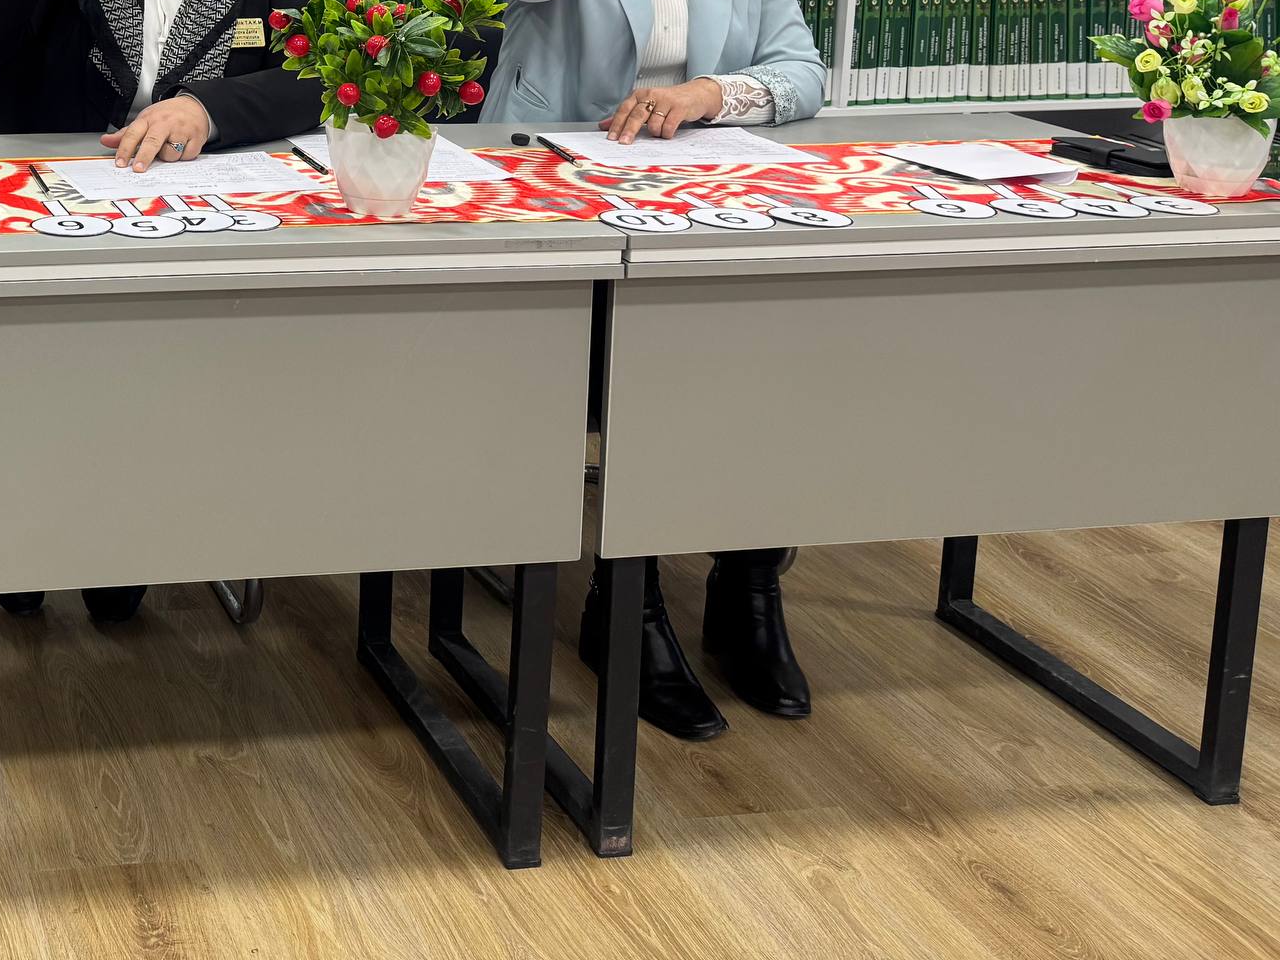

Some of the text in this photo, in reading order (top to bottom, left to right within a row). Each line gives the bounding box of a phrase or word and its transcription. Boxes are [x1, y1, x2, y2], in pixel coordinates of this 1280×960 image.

[935, 203, 966, 213] 6
[1016, 202, 1048, 213] 5
[1087, 202, 1117, 213] 4
[1158, 200, 1183, 210] 3
[181, 215, 206, 227] 4
[233, 215, 256, 227] 3
[617, 213, 675, 226] 10
[722, 212, 748, 225] 9
[789, 211, 828, 222] 8
[56, 219, 85, 232] 6
[136, 220, 159, 233] 5
